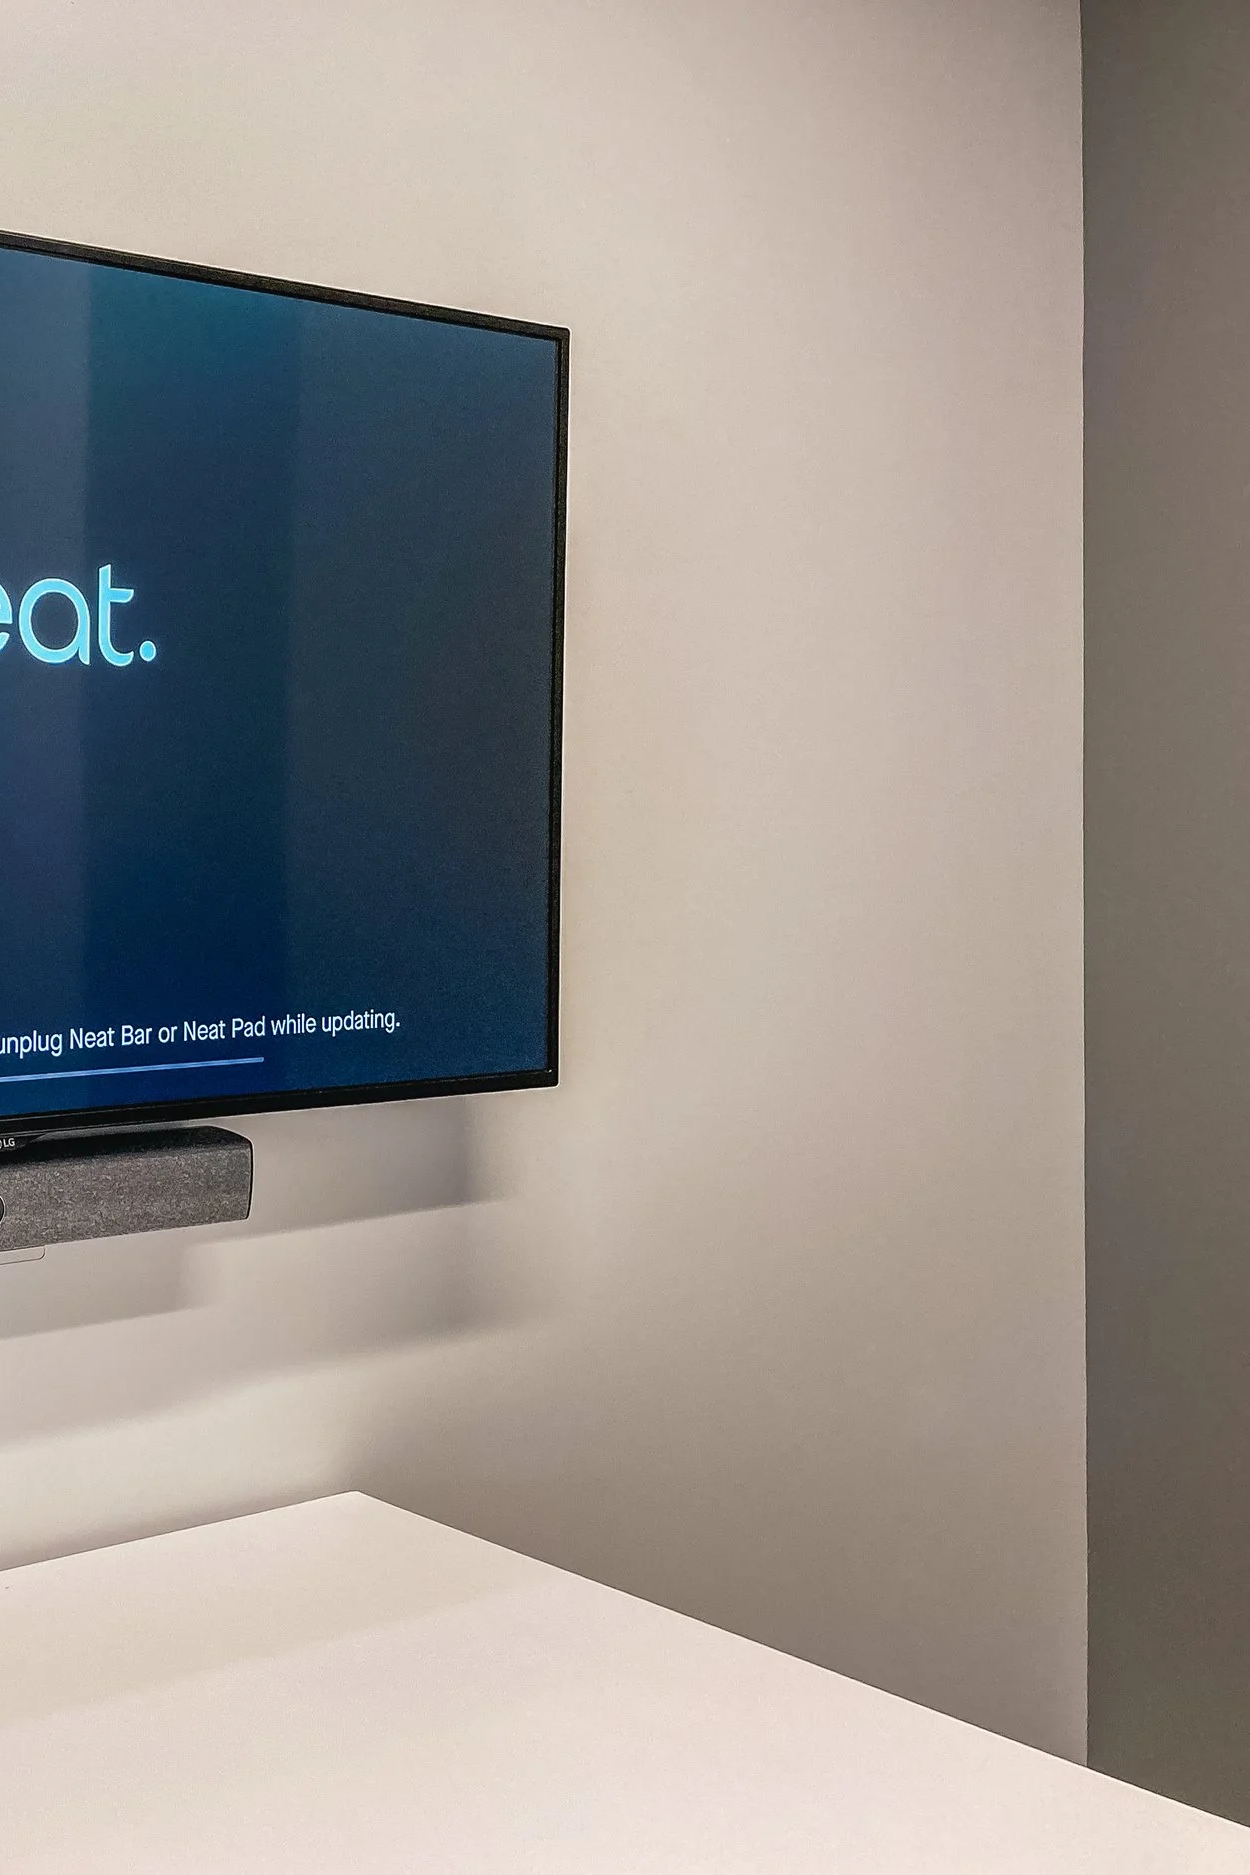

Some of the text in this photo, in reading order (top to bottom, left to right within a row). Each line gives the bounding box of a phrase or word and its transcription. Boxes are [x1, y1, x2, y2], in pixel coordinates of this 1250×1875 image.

[69, 1027, 115, 1049] Neat
[121, 1024, 152, 1046] Bar
[158, 1025, 178, 1043] or
[183, 1019, 226, 1042] Neat
[231, 1016, 266, 1038] Pad
[271, 1013, 317, 1036] while
[321, 1009, 401, 1037] updating.
[3, 1137, 15, 1148] LG
